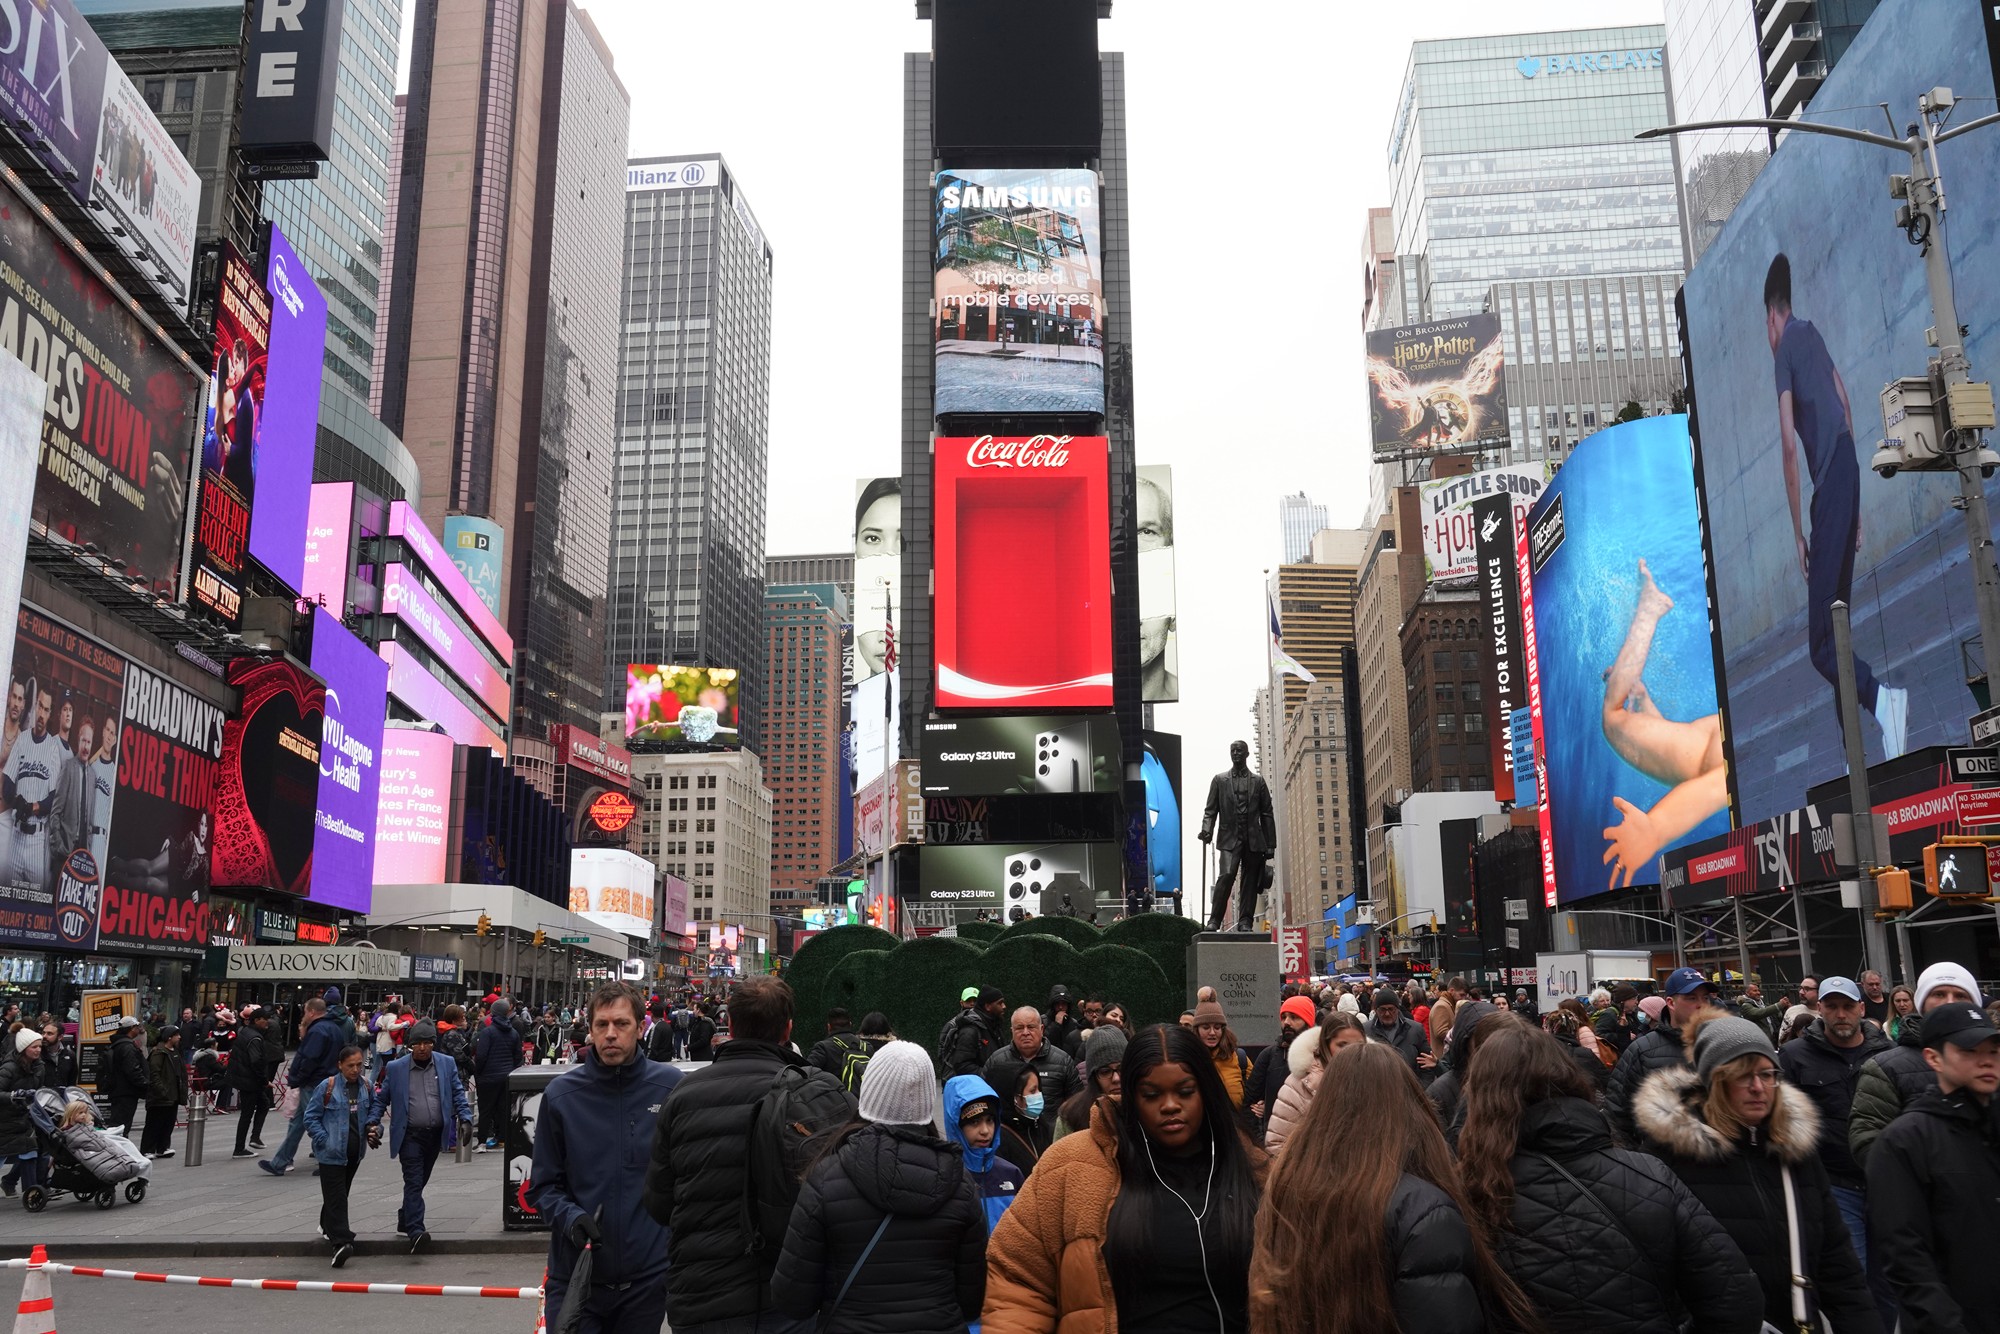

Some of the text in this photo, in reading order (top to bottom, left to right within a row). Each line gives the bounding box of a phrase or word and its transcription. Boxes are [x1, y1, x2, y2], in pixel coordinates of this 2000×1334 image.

[1547, 48, 1662, 75] BARCLAYS
[2, 64, 20, 95] THE
[117, 89, 129, 106] AND
[22, 87, 57, 139] MUSICAL
[162, 175, 193, 221] THE PLAY
[943, 186, 1092, 208] SAMSUNG
[104, 194, 116, 211] NEW
[115, 205, 132, 233] WORLD
[130, 226, 147, 249] STAGES
[157, 185, 174, 213] THAT
[173, 206, 193, 242] GOES
[155, 201, 190, 263] WRONG
[233, 267, 248, 297] TONY
[975, 271, 1064, 285] Unlocked
[281, 288, 298, 318] Health
[944, 291, 1010, 306] mobile
[0, 260, 132, 395] COME SEE HOW THE WORLD COULD BE.
[1396, 321, 1469, 339] ON BROADWAY
[1392, 336, 1477, 368] Harry Potter
[1410, 358, 1461, 371] CURSED CHILD
[51, 425, 69, 454] AND
[966, 434, 1074, 468] Coca-Cola
[47, 448, 101, 507] MUSICAL
[1433, 473, 1542, 515] LITTLE SHOP
[202, 478, 243, 537] MOULIN
[313, 527, 334, 538] Age
[406, 516, 434, 561] Luxury News
[1433, 566, 1466, 578] Westside
[194, 568, 220, 600] AARON
[219, 585, 241, 614] TVEIT
[1488, 556, 1508, 656] EXCELLENCE
[409, 595, 453, 654] Market Winner
[1519, 552, 1541, 718] FREE CHOCOLATE
[51, 621, 64, 645] HIT
[66, 632, 76, 652] OF
[78, 638, 92, 662] THE
[93, 648, 124, 676] SEASON!
[1496, 660, 1511, 694] FOR
[125, 663, 225, 758] BROADWAY'S
[1500, 699, 1512, 721] UP
[925, 723, 957, 731] SAMSUNG
[1976, 722, 1991, 739] ONE
[339, 725, 373, 768] Langone
[396, 748, 420, 757] News
[940, 750, 1016, 763] Galaxy S23 Ultra
[1502, 726, 1514, 772] TEAM
[118, 724, 220, 815] SURE THING
[333, 755, 361, 793] Health
[1966, 758, 1999, 772] ONE
[412, 783, 435, 798] Age
[603, 795, 624, 803] HOT
[407, 800, 442, 814] France
[1900, 795, 1956, 824] BROADWAY
[1960, 801, 1988, 810] Anytime
[384, 815, 443, 831] New Stock
[601, 819, 623, 828] NOW
[407, 831, 442, 845] Winner
[1753, 813, 1794, 887] TSX
[1707, 855, 1737, 873] BROADWAY
[12, 889, 28, 900] TYLER
[27, 890, 53, 904] FERGUSON
[59, 872, 82, 904] TAKE
[81, 884, 99, 914] ME
[930, 889, 995, 899] Galaxy S23 Ultra
[33, 914, 52, 930] ONLY
[63, 911, 84, 937] OUT
[100, 886, 209, 944] CHICAGO
[263, 911, 297, 931] BLUE FIN
[229, 953, 357, 972] SWAROVSKI
[1283, 931, 1303, 973] tkts
[360, 951, 401, 977] SWAROVSKI
[415, 960, 433, 971] BLUE FIN
[433, 959, 456, 974] NOW OPEN
[1412, 964, 1432, 972] NYC
[1503, 969, 1523, 977] Sale
[1220, 973, 1257, 982] GEORGE
[94, 999, 121, 1011] EXPLORE
[1223, 990, 1256, 998] COHAN
[95, 1009, 112, 1019] MORE
[95, 1013, 121, 1027] IN TIMES
[95, 1021, 120, 1034] SQUARE
